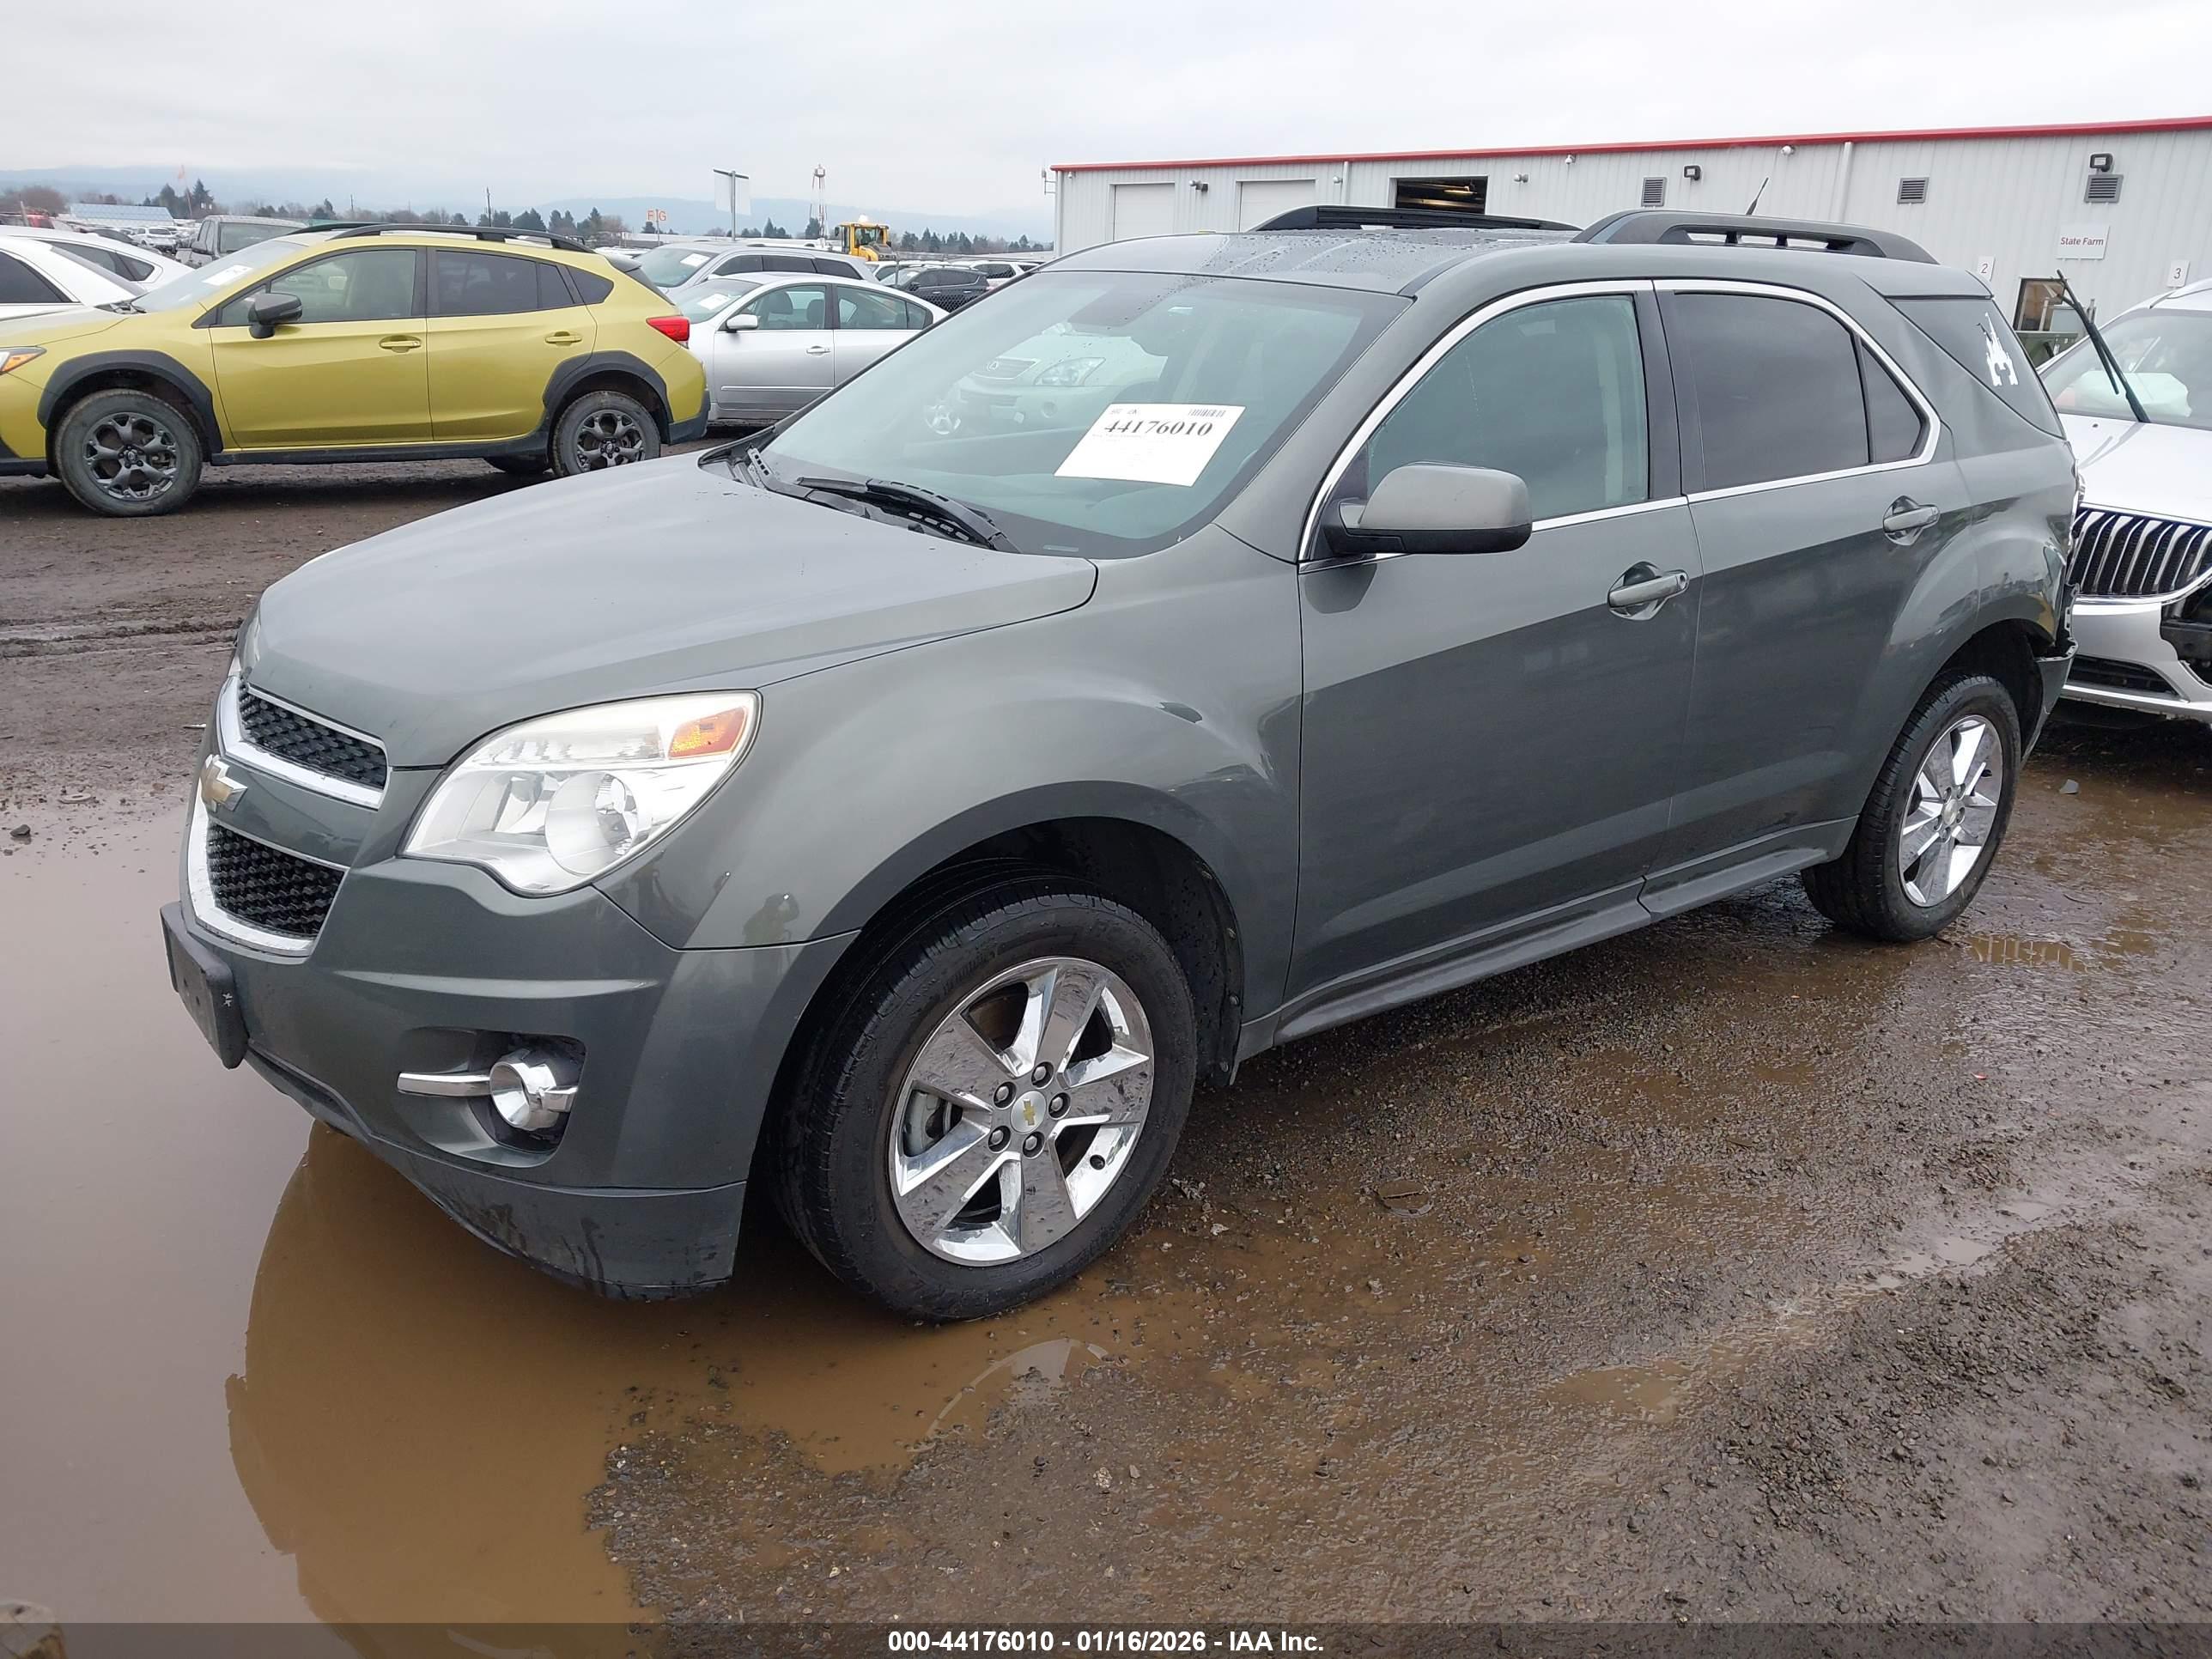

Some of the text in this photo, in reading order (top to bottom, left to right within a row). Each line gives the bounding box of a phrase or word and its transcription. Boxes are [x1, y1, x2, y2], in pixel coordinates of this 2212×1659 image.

[647, 210, 653, 221] F
[659, 210, 666, 221] G
[2061, 236, 2104, 246] State Farm
[1980, 263, 1989, 274] 2
[2173, 267, 2182, 279] 3
[1104, 420, 1213, 436] 44176010
